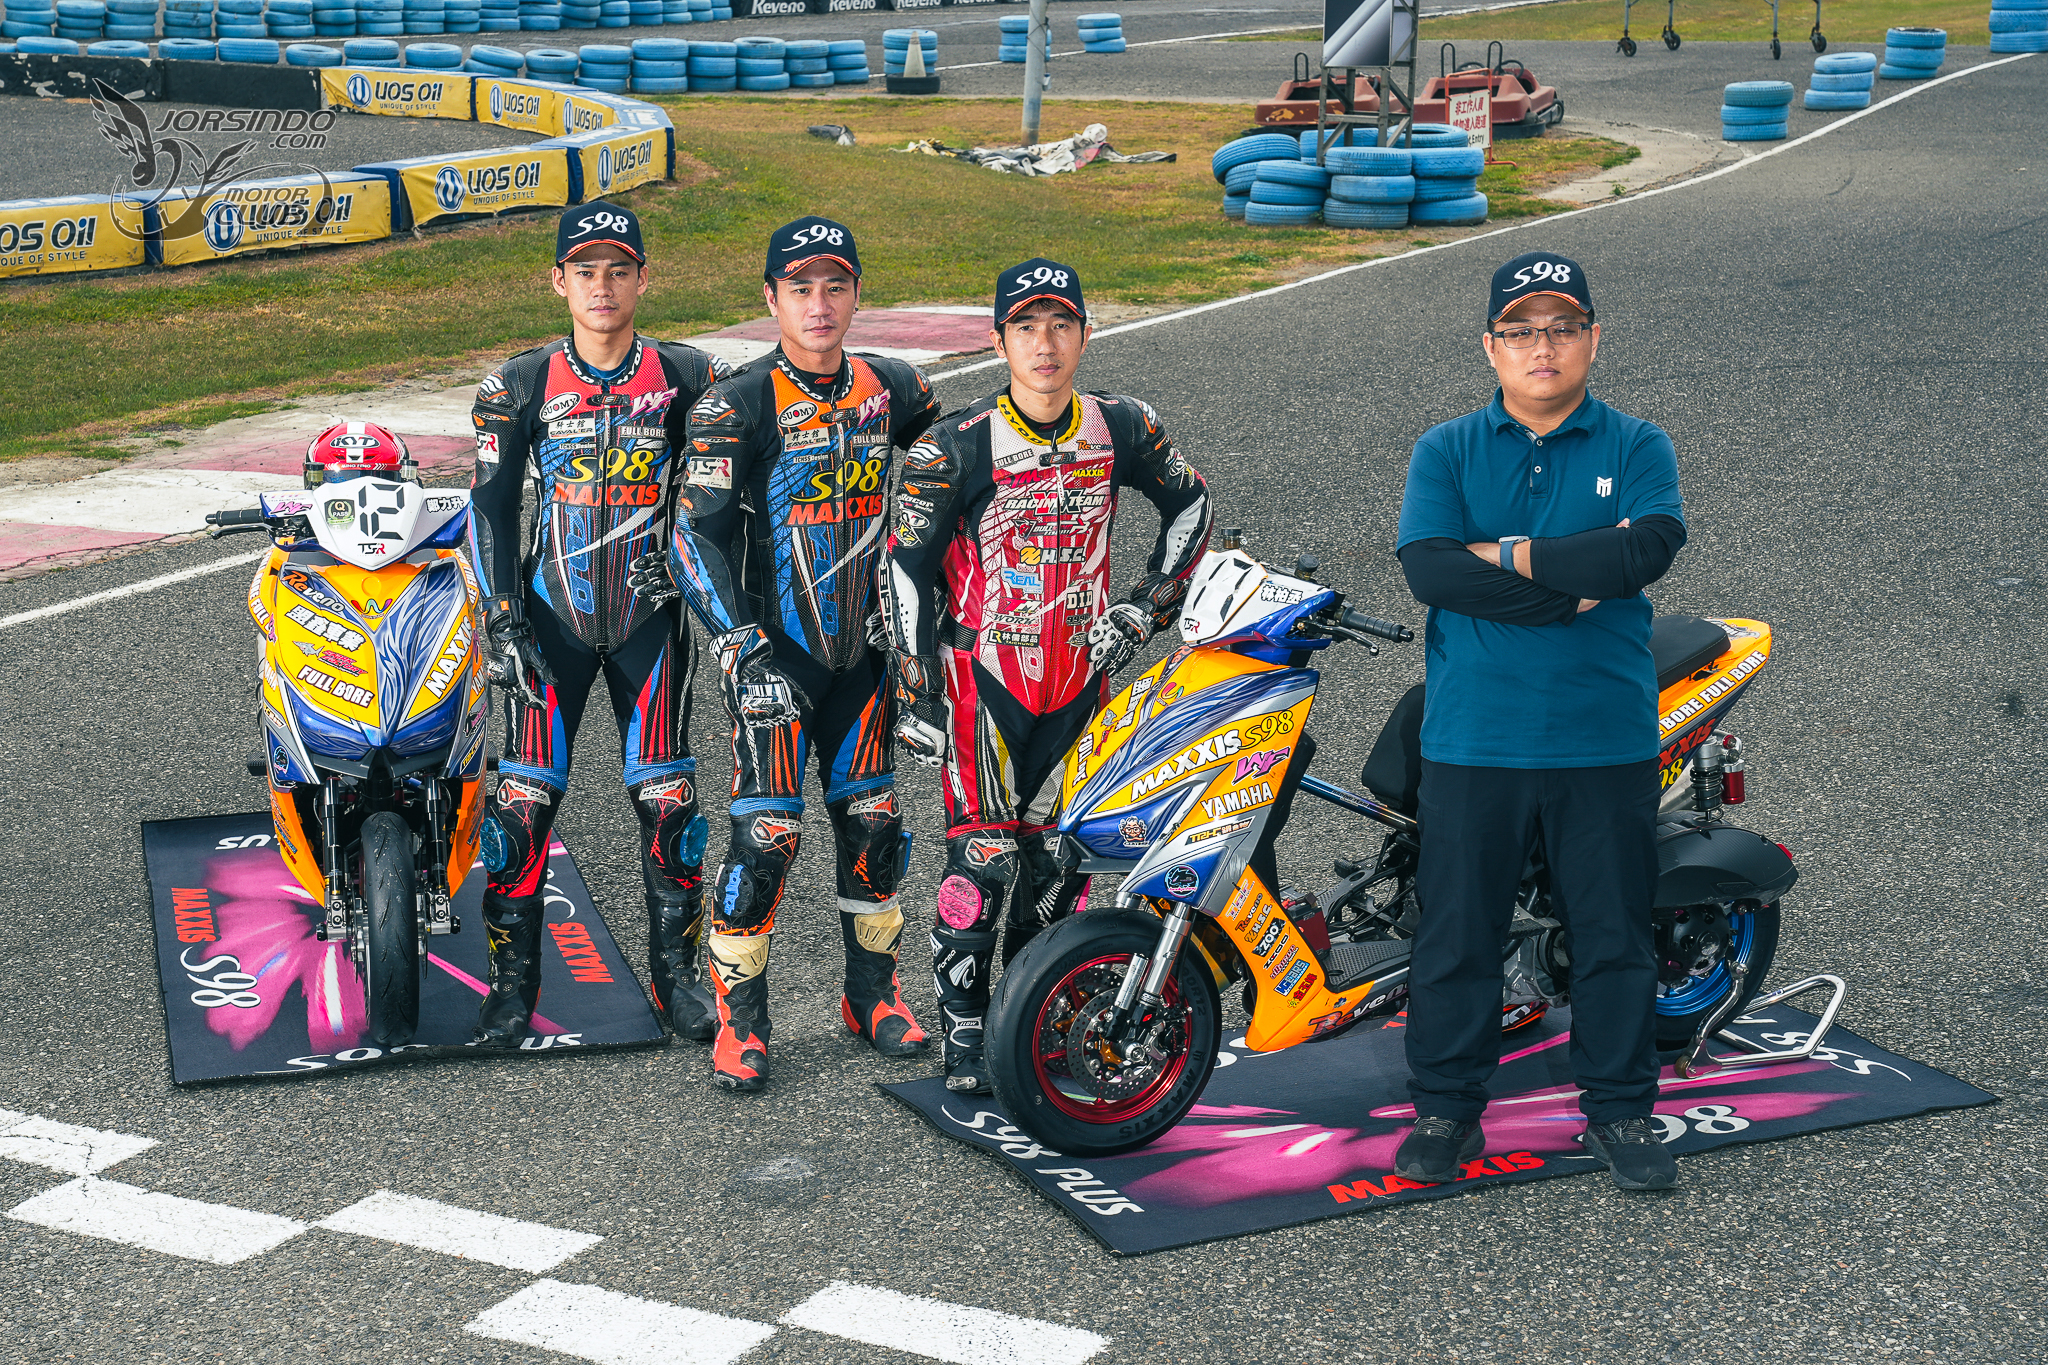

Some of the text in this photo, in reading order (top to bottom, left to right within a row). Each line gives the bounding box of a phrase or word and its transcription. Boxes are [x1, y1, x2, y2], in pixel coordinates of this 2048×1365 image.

[375, 81, 443, 103] UOS Oil
[503, 92, 540, 118] UOS Oil
[379, 102, 437, 111] UNIQUE OF STYLE
[574, 106, 591, 131] UOS
[613, 139, 652, 174] UOS Oil
[467, 161, 541, 196] UOS Oil
[315, 193, 354, 223] Oil
[473, 190, 535, 206] UNIQUE OF STYLE
[50, 214, 98, 250] Oil
[256, 230, 293, 242] UNIQUE
[312, 225, 344, 236] STYLE
[568, 211, 629, 239] S98
[781, 224, 844, 252] S98
[28, 254, 43, 264] OF
[47, 250, 86, 262] STYLE
[1006, 266, 1069, 297] S98
[1502, 261, 1571, 293] S98
[776, 360, 824, 401] HYOD
[543, 396, 579, 417] SUOMY
[781, 407, 816, 422] SUOMY
[550, 427, 594, 436] CAVALIER
[622, 428, 666, 437] FULL BORE
[1000, 403, 1043, 445] HYOD
[853, 435, 888, 444] FULL BORE
[1077, 440, 1113, 451] Reveno
[552, 448, 655, 484] S98
[994, 449, 1034, 469] FULL BORE
[1071, 468, 1105, 478] MAXXIS
[788, 458, 883, 503] S98
[998, 468, 1041, 489] SYM
[552, 483, 660, 507] MAXXIS
[1068, 495, 1106, 507] TEAM
[357, 483, 406, 541] 12
[786, 495, 884, 527] MAXXIS
[357, 542, 387, 555] TSR
[281, 570, 346, 613] Reveno
[1003, 570, 1041, 587] REAL
[993, 613, 1038, 625] WORK
[297, 664, 337, 694] FULL
[331, 680, 376, 709] BORE
[1659, 650, 1769, 731] BORE FULL BORE
[1130, 729, 1243, 802] MAXXIS
[1238, 709, 1295, 751] S98
[1200, 781, 1274, 819] YAMAHA
[170, 887, 220, 943] MAXXIS
[1235, 892, 1264, 933] Reveno
[547, 921, 615, 983] MAXXIS
[1260, 925, 1280, 952] ZOO
[179, 944, 261, 1009] S98
[1036, 1167, 1145, 1217] PLUS
